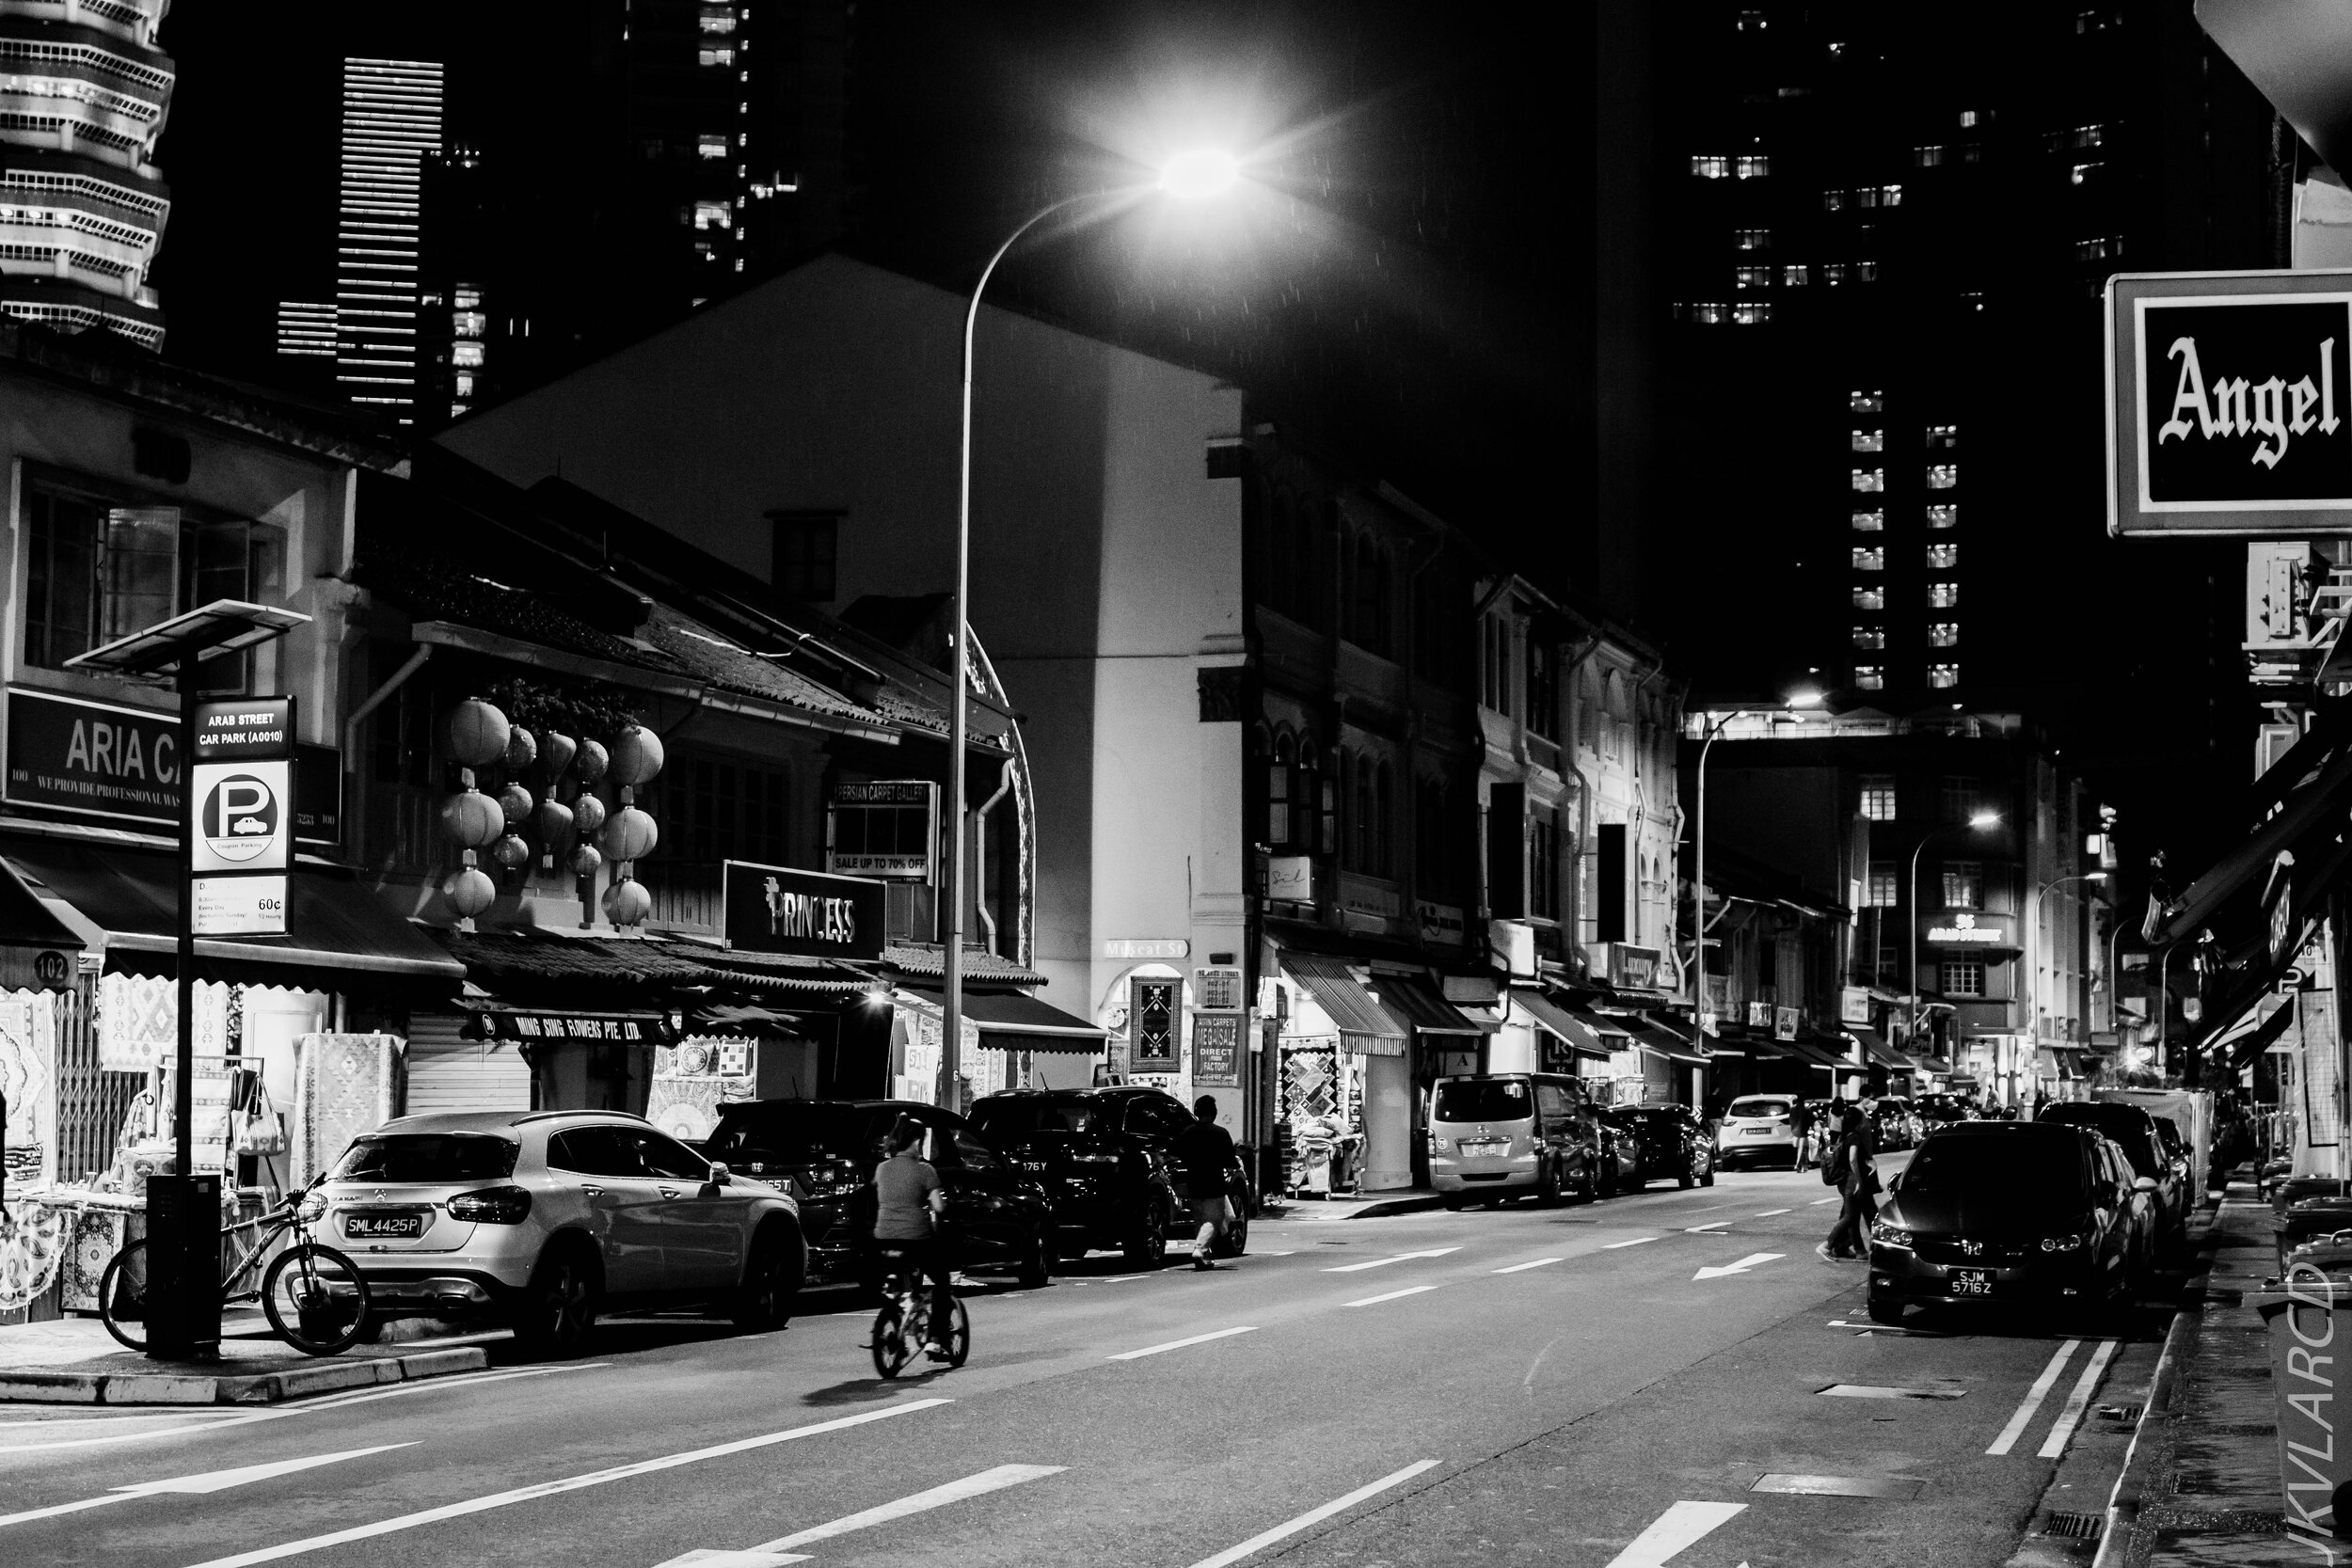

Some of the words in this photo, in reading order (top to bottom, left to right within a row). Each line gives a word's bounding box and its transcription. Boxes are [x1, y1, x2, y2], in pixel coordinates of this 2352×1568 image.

[2159, 337, 2341, 469] Angel
[209, 715, 235, 726] ARAB
[239, 713, 274, 725] STREET
[199, 735, 219, 745] CAR
[222, 733, 246, 744] PARK
[248, 730, 282, 743] (A0010)
[66, 719, 146, 780] ARIA
[154, 733, 180, 784] C
[38, 775, 54, 790] WE
[55, 778, 95, 796] PROVIDE
[97, 784, 162, 805] PROFESSIONAL
[838, 785, 867, 801] PERSIAN
[868, 785, 895, 800] CARPET
[218, 781, 270, 837] P
[835, 858, 858, 869] SALE
[860, 858, 873, 868] UP
[874, 858, 886, 868] TO
[888, 859, 906, 869] 70%
[908, 859, 926, 869] OFF
[771, 892, 855, 943] PRINCESS
[1106, 942, 1161, 956] Muscat
[1168, 942, 1183, 955] St
[40, 958, 64, 978] 102
[515, 1017, 541, 1036] MING
[543, 1019, 565, 1037] SING
[566, 1020, 602, 1038] FLOWERS
[604, 1022, 622, 1039] PTE.
[624, 1022, 643, 1039] LTD.
[1213, 1018, 1236, 1027] CARPETS
[1197, 1028, 1217, 1045] MEGA
[1219, 1028, 1236, 1046] SALE
[1204, 1062, 1230, 1071] FACTORY
[348, 1219, 418, 1232] SML4425P
[1960, 1271, 1985, 1282] SJM
[1952, 1281, 1992, 1293] 5716Z
